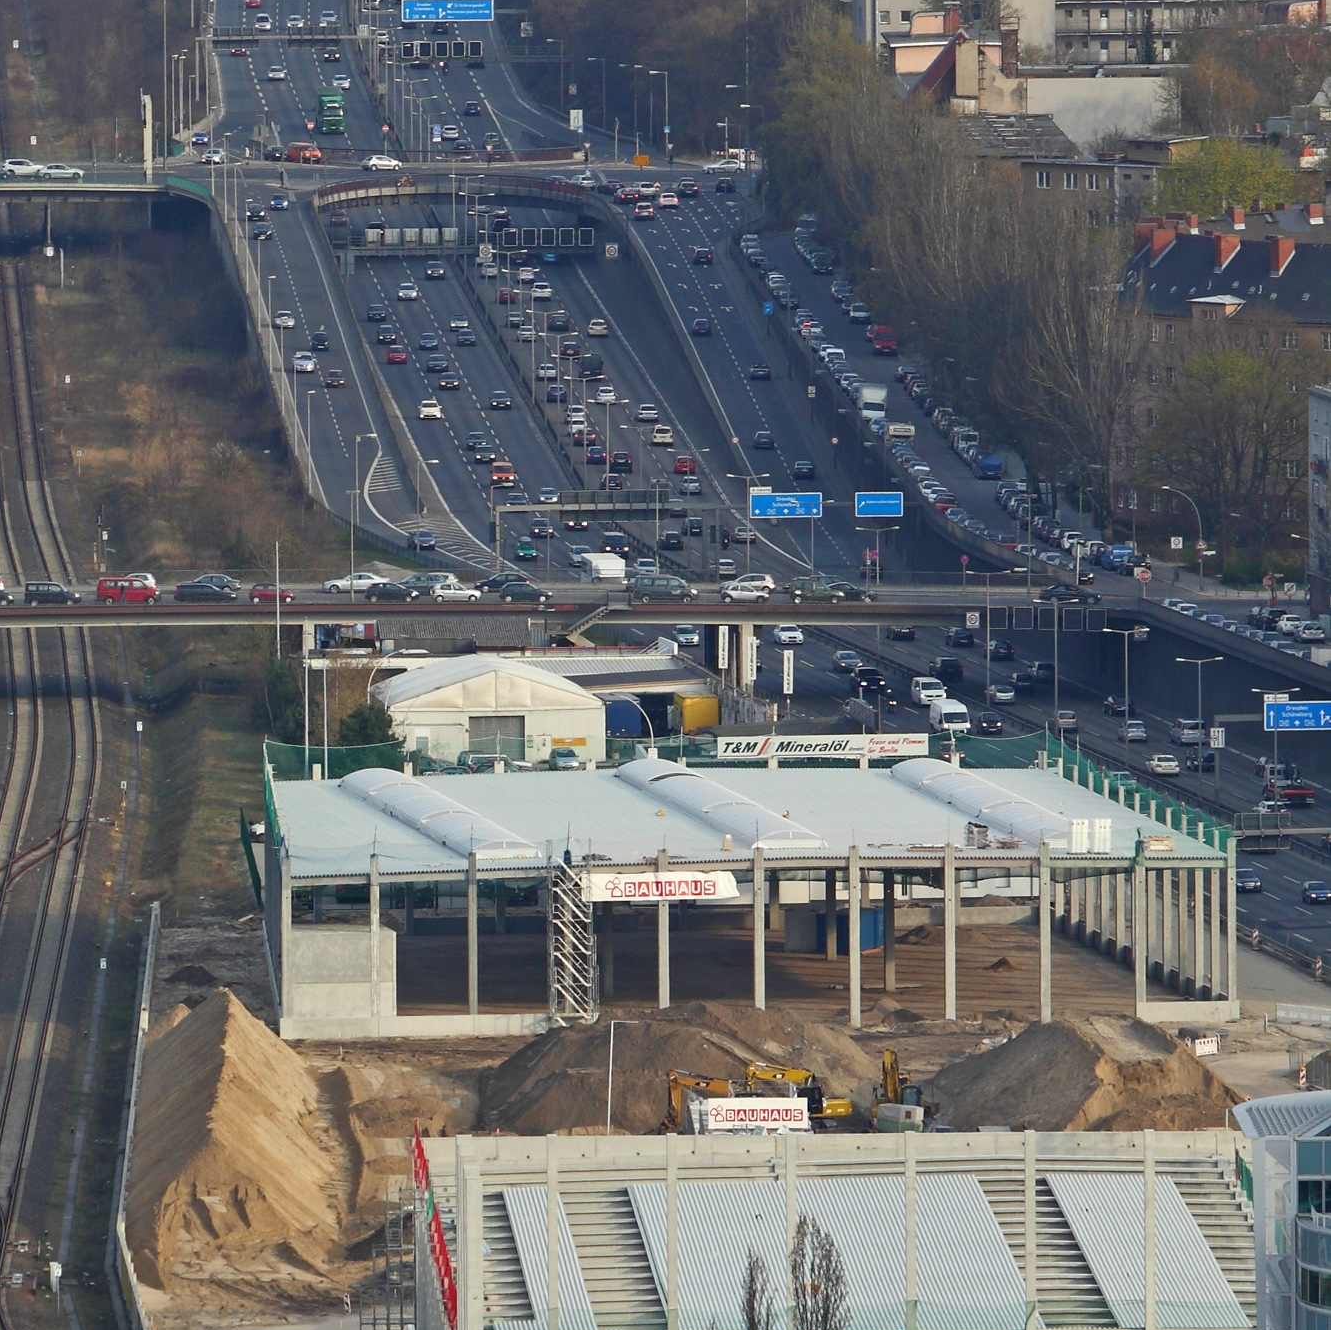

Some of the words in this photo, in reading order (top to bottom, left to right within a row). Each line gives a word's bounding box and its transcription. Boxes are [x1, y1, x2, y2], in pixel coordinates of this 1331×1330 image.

[723, 742, 758, 753] T&M
[775, 739, 850, 753] Mineralöl
[879, 746, 898, 754] Berlin
[625, 880, 716, 897] BAUHAUS
[726, 1109, 803, 1122] BAUHAUS
